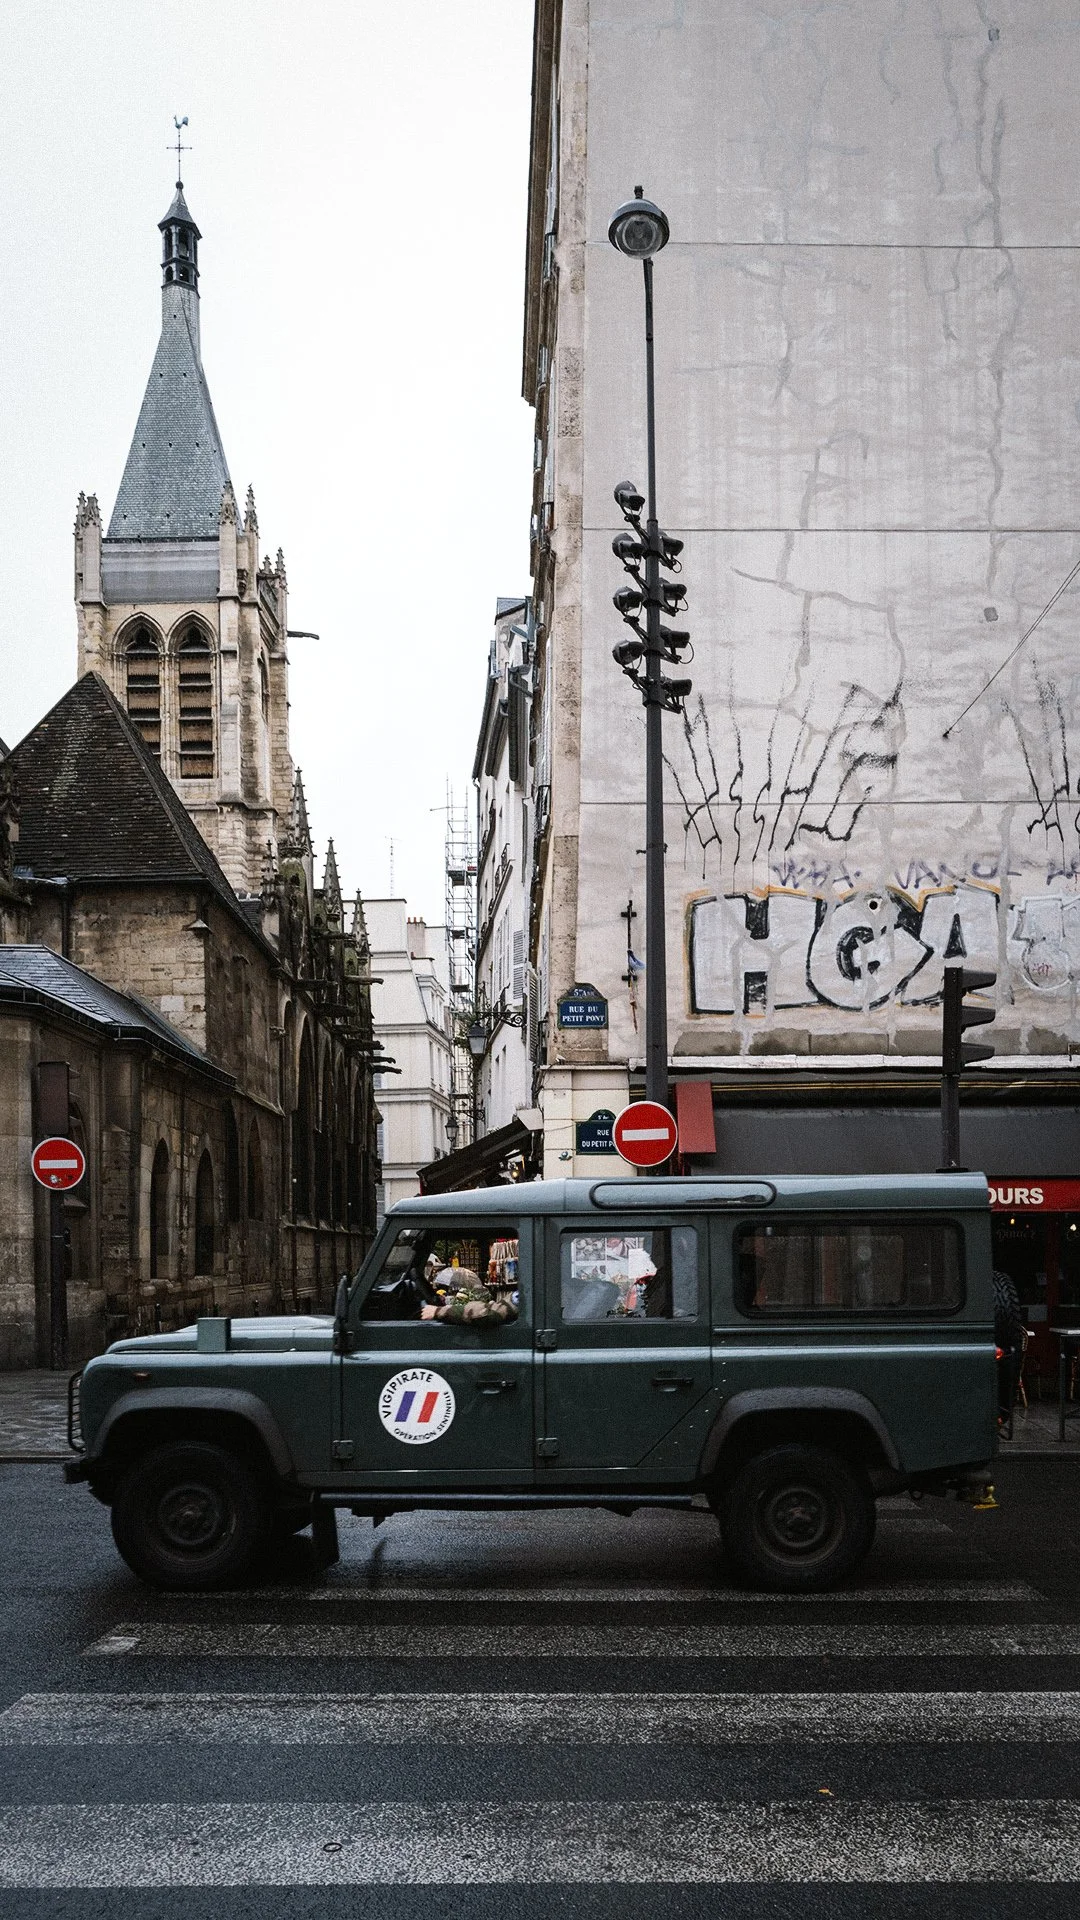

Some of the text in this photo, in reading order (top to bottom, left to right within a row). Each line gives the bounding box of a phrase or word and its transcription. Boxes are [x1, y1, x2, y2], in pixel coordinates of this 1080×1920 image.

[581, 1140, 591, 1148] DU
[591, 1140, 608, 1148] PETIT
[382, 1371, 434, 1419] VIGIPIRATE
